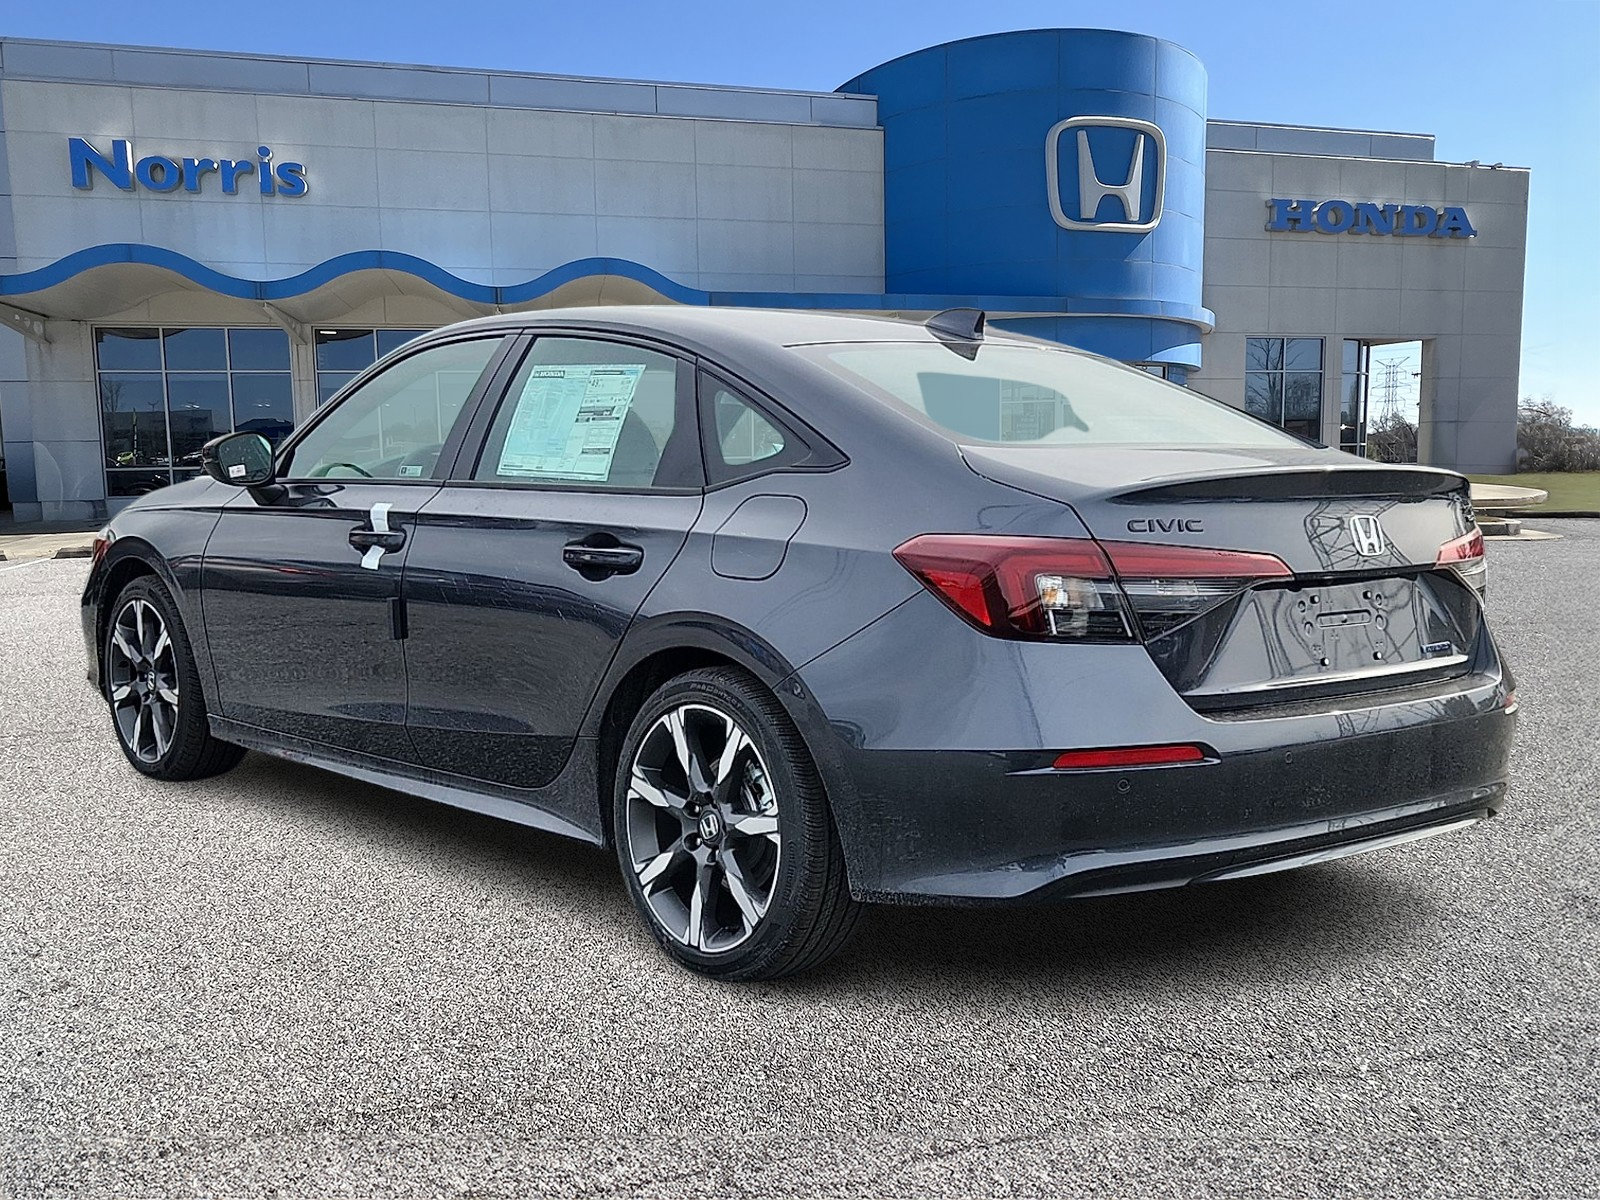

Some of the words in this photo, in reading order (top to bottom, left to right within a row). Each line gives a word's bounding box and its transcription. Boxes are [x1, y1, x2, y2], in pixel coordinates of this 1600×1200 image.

[68, 137, 308, 197] Norris
[1265, 198, 1478, 239] HONDA
[1127, 518, 1204, 533] CIVIC
